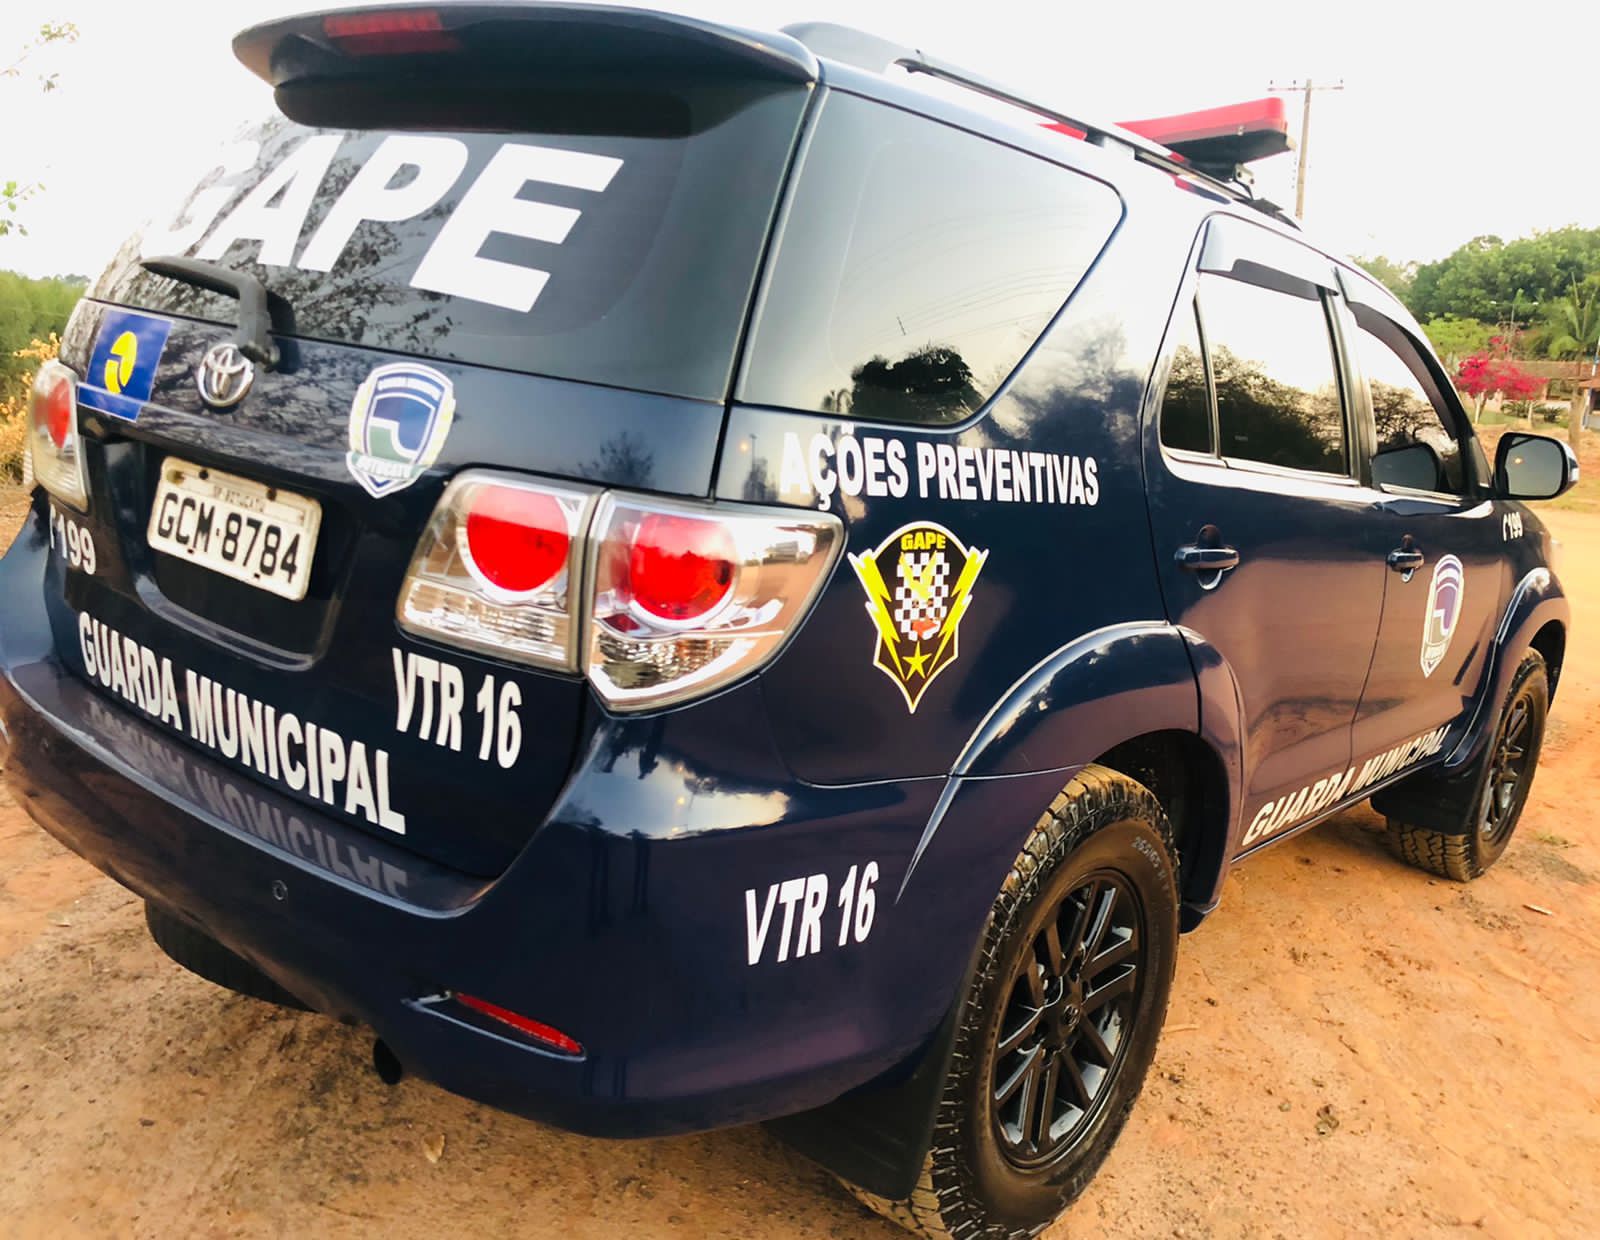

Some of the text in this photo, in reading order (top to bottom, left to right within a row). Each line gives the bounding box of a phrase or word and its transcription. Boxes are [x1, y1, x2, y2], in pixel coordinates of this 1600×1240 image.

[140, 132, 624, 312] GAPE
[916, 441, 1100, 506] PREVENTIVAS
[57, 513, 97, 575] 199
[901, 531, 946, 550] GAPE
[79, 611, 407, 835] GUARDA MUNICIPAL
[392, 647, 523, 769] VTR 16
[1242, 724, 1452, 846] GUARDA MUNICIPAL
[745, 860, 879, 966] VTR 16
